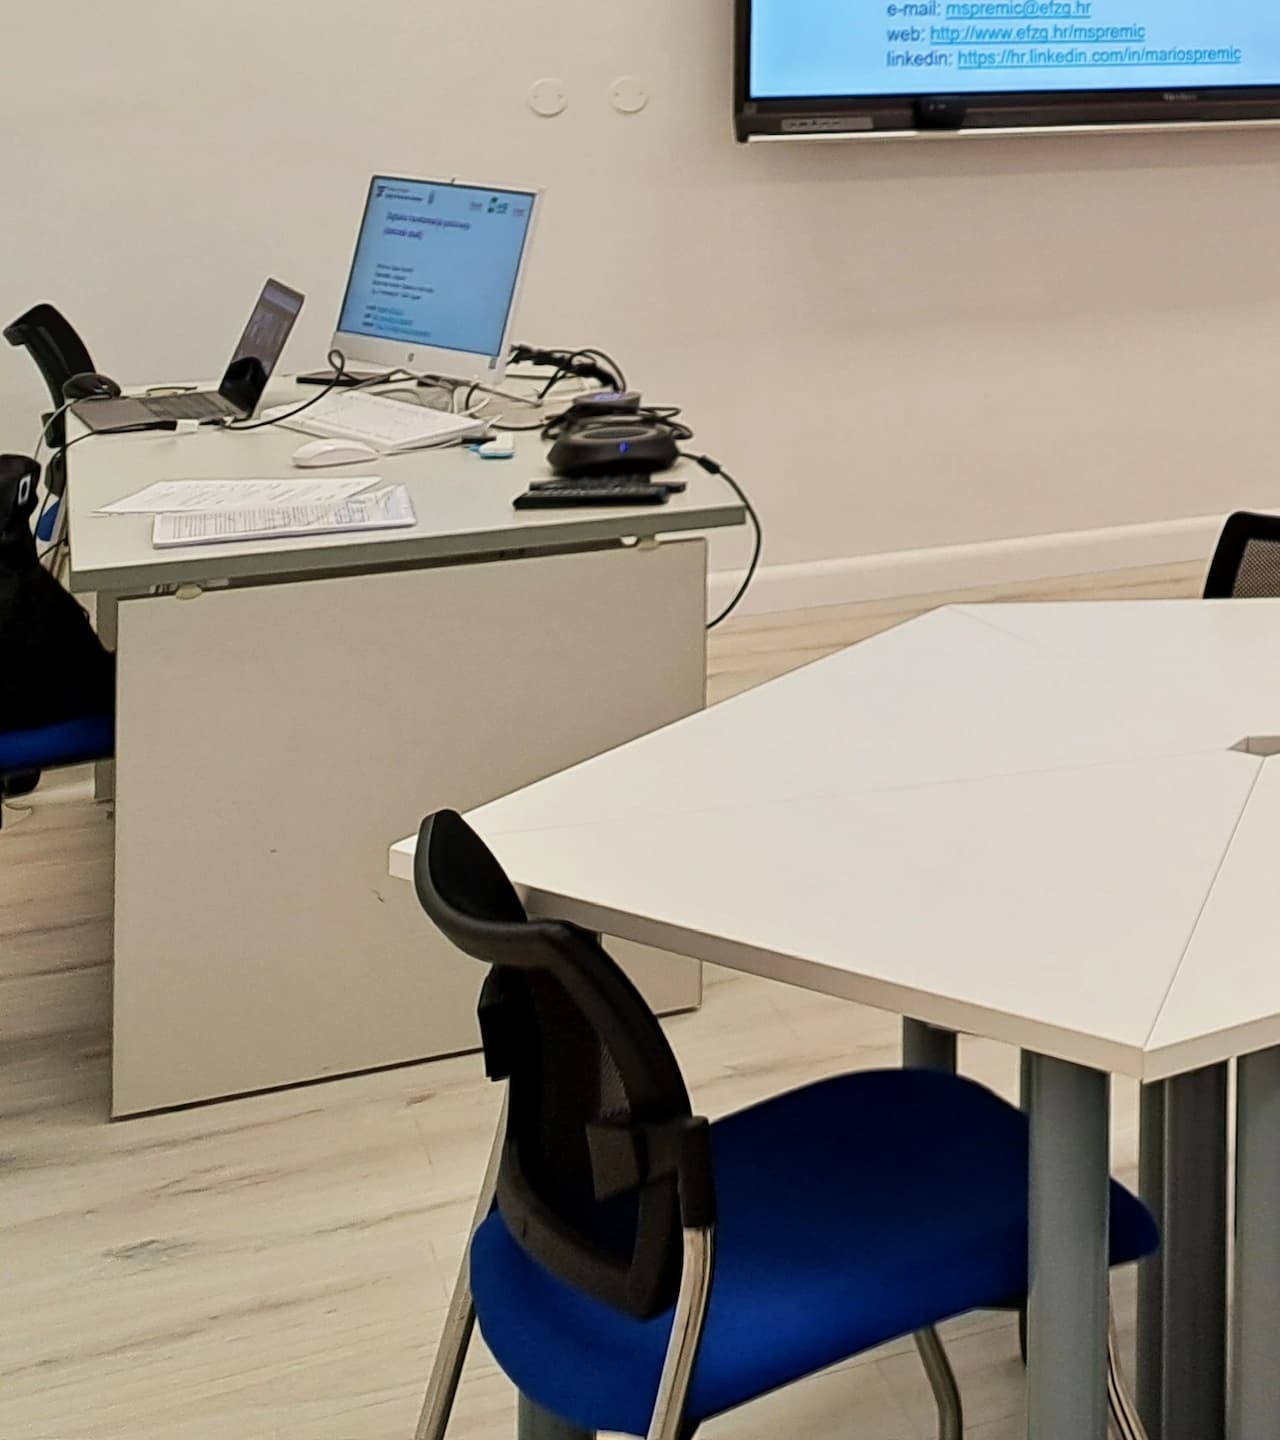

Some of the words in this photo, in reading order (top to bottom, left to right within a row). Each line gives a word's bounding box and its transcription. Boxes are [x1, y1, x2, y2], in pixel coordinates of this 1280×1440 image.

[887, 1, 941, 17] e-mail:
[946, 0, 1092, 20] mspremic@efzg.hr
[887, 26, 926, 42] web:
[930, 23, 1146, 45] http://www.efzg.hr/mspremic
[887, 51, 953, 67] linkedin:
[958, 46, 1242, 70] https://hr.linkedin.com/in/mariospremic
